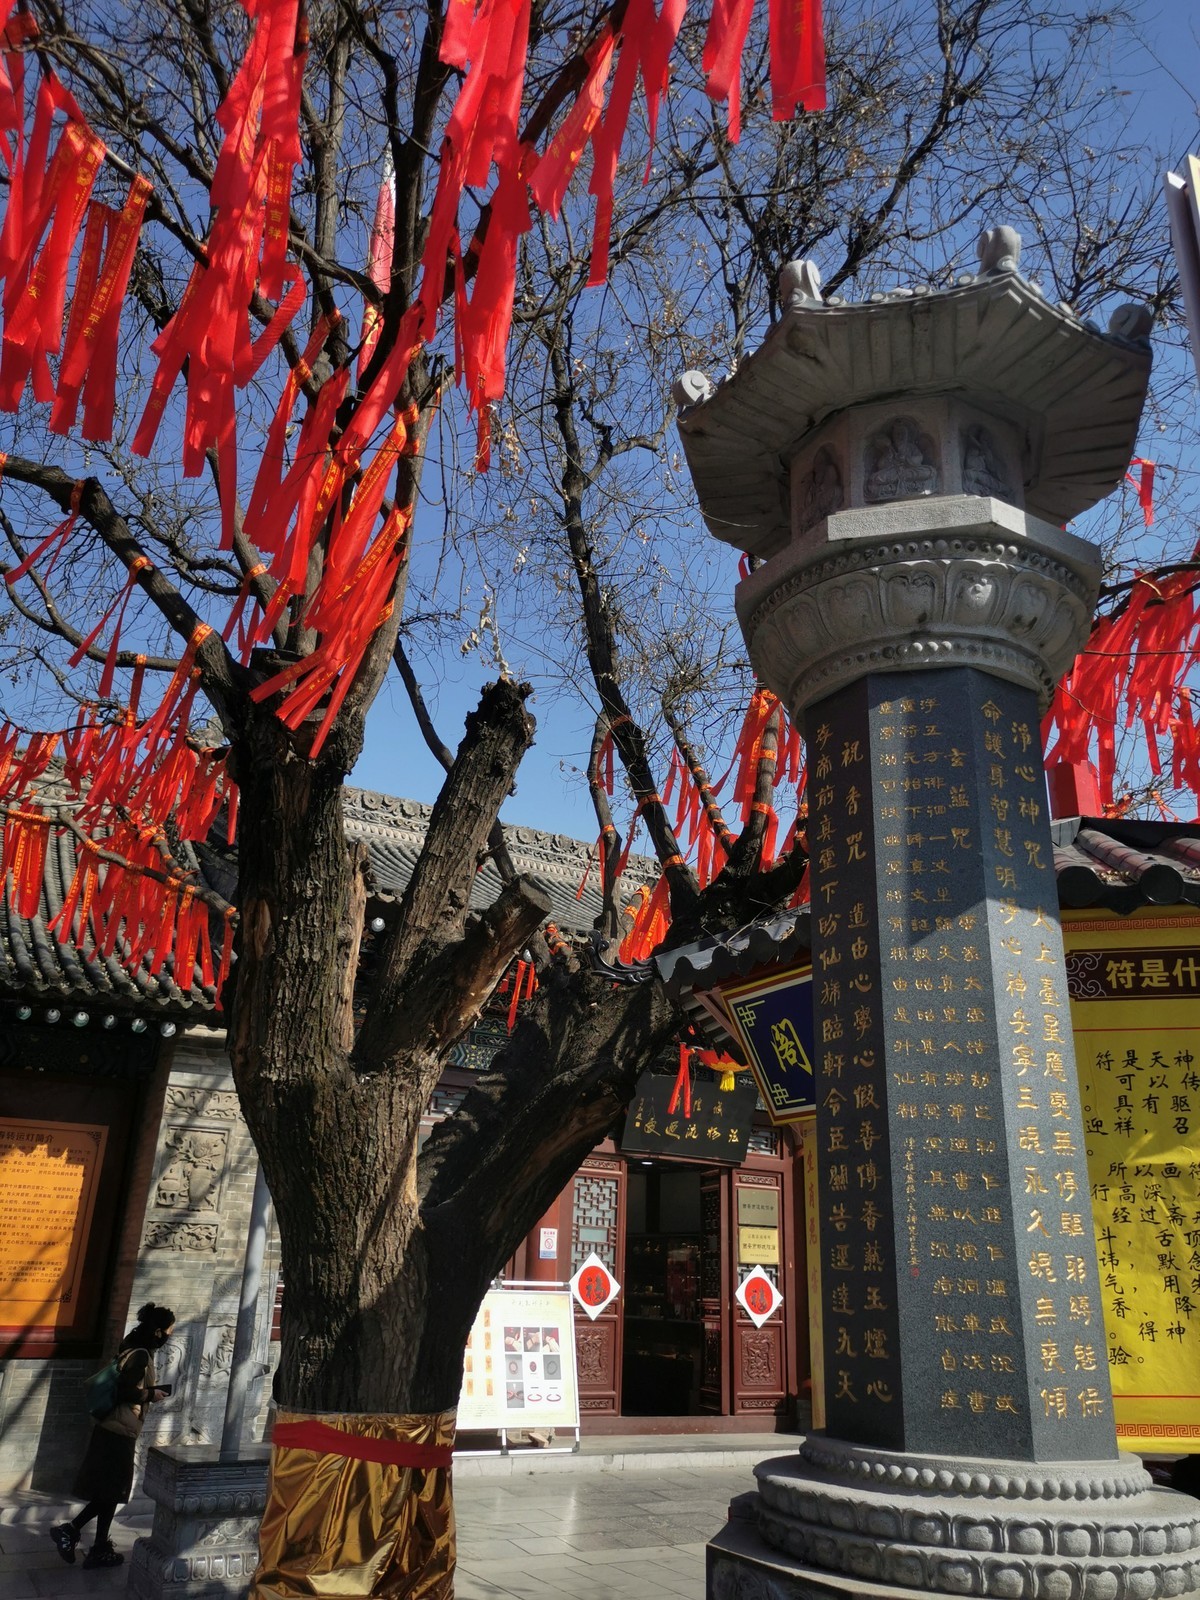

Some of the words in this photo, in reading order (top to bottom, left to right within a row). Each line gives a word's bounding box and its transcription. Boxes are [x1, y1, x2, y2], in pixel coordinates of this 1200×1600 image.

[840, 740, 868, 864] 祝香咒
[1105, 957, 1200, 989] 符是什
[1095, 1049, 1194, 1072] 符是天神
